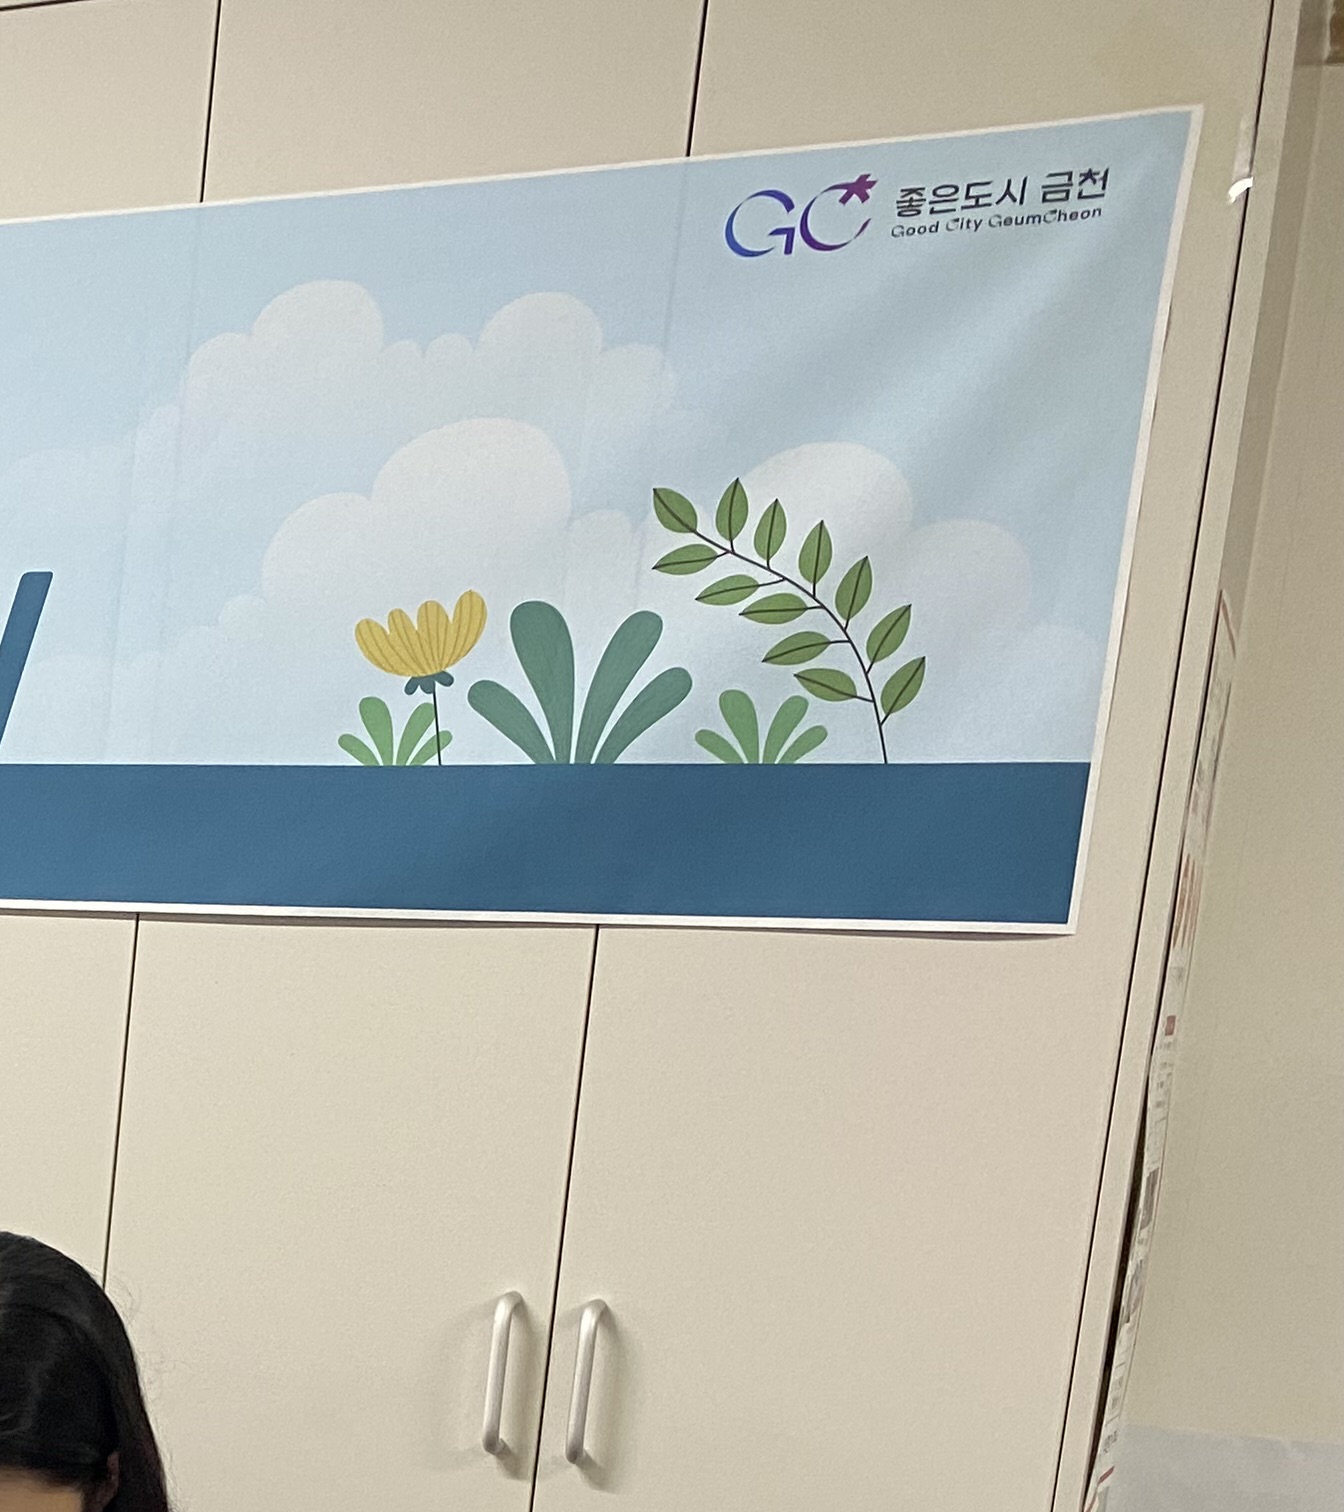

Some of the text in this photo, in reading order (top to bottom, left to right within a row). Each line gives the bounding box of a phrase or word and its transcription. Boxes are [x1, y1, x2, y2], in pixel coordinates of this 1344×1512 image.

[896, 167, 1110, 218] 좋은도시 금천
[891, 220, 940, 238] Good
[946, 216, 984, 235] City
